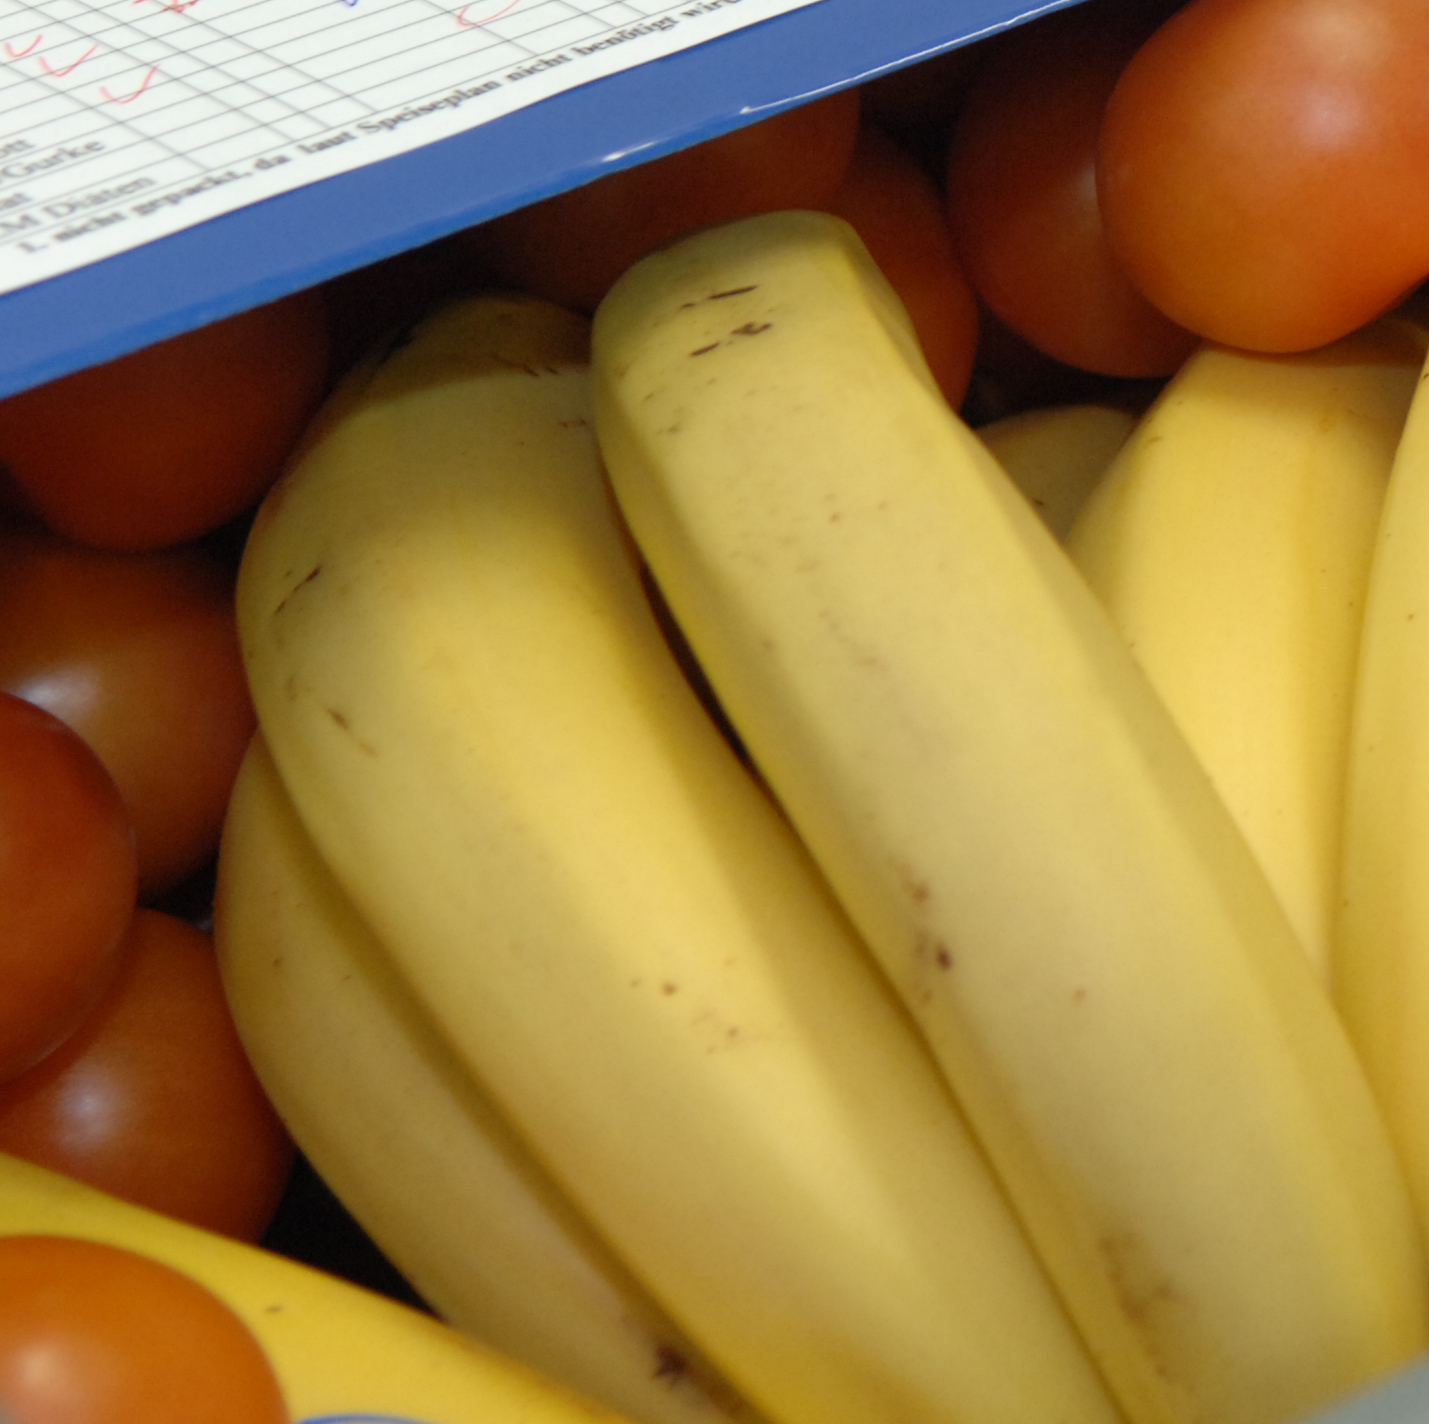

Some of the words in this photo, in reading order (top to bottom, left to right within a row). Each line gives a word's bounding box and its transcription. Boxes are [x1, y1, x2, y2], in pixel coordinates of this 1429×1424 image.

[253, 154, 291, 170] da
[297, 131, 356, 154] laut
[357, 79, 501, 133] Speiseplan
[504, 53, 572, 82] nicht
[573, 14, 679, 57] benötigt
[1, 141, 104, 177] Gurke
